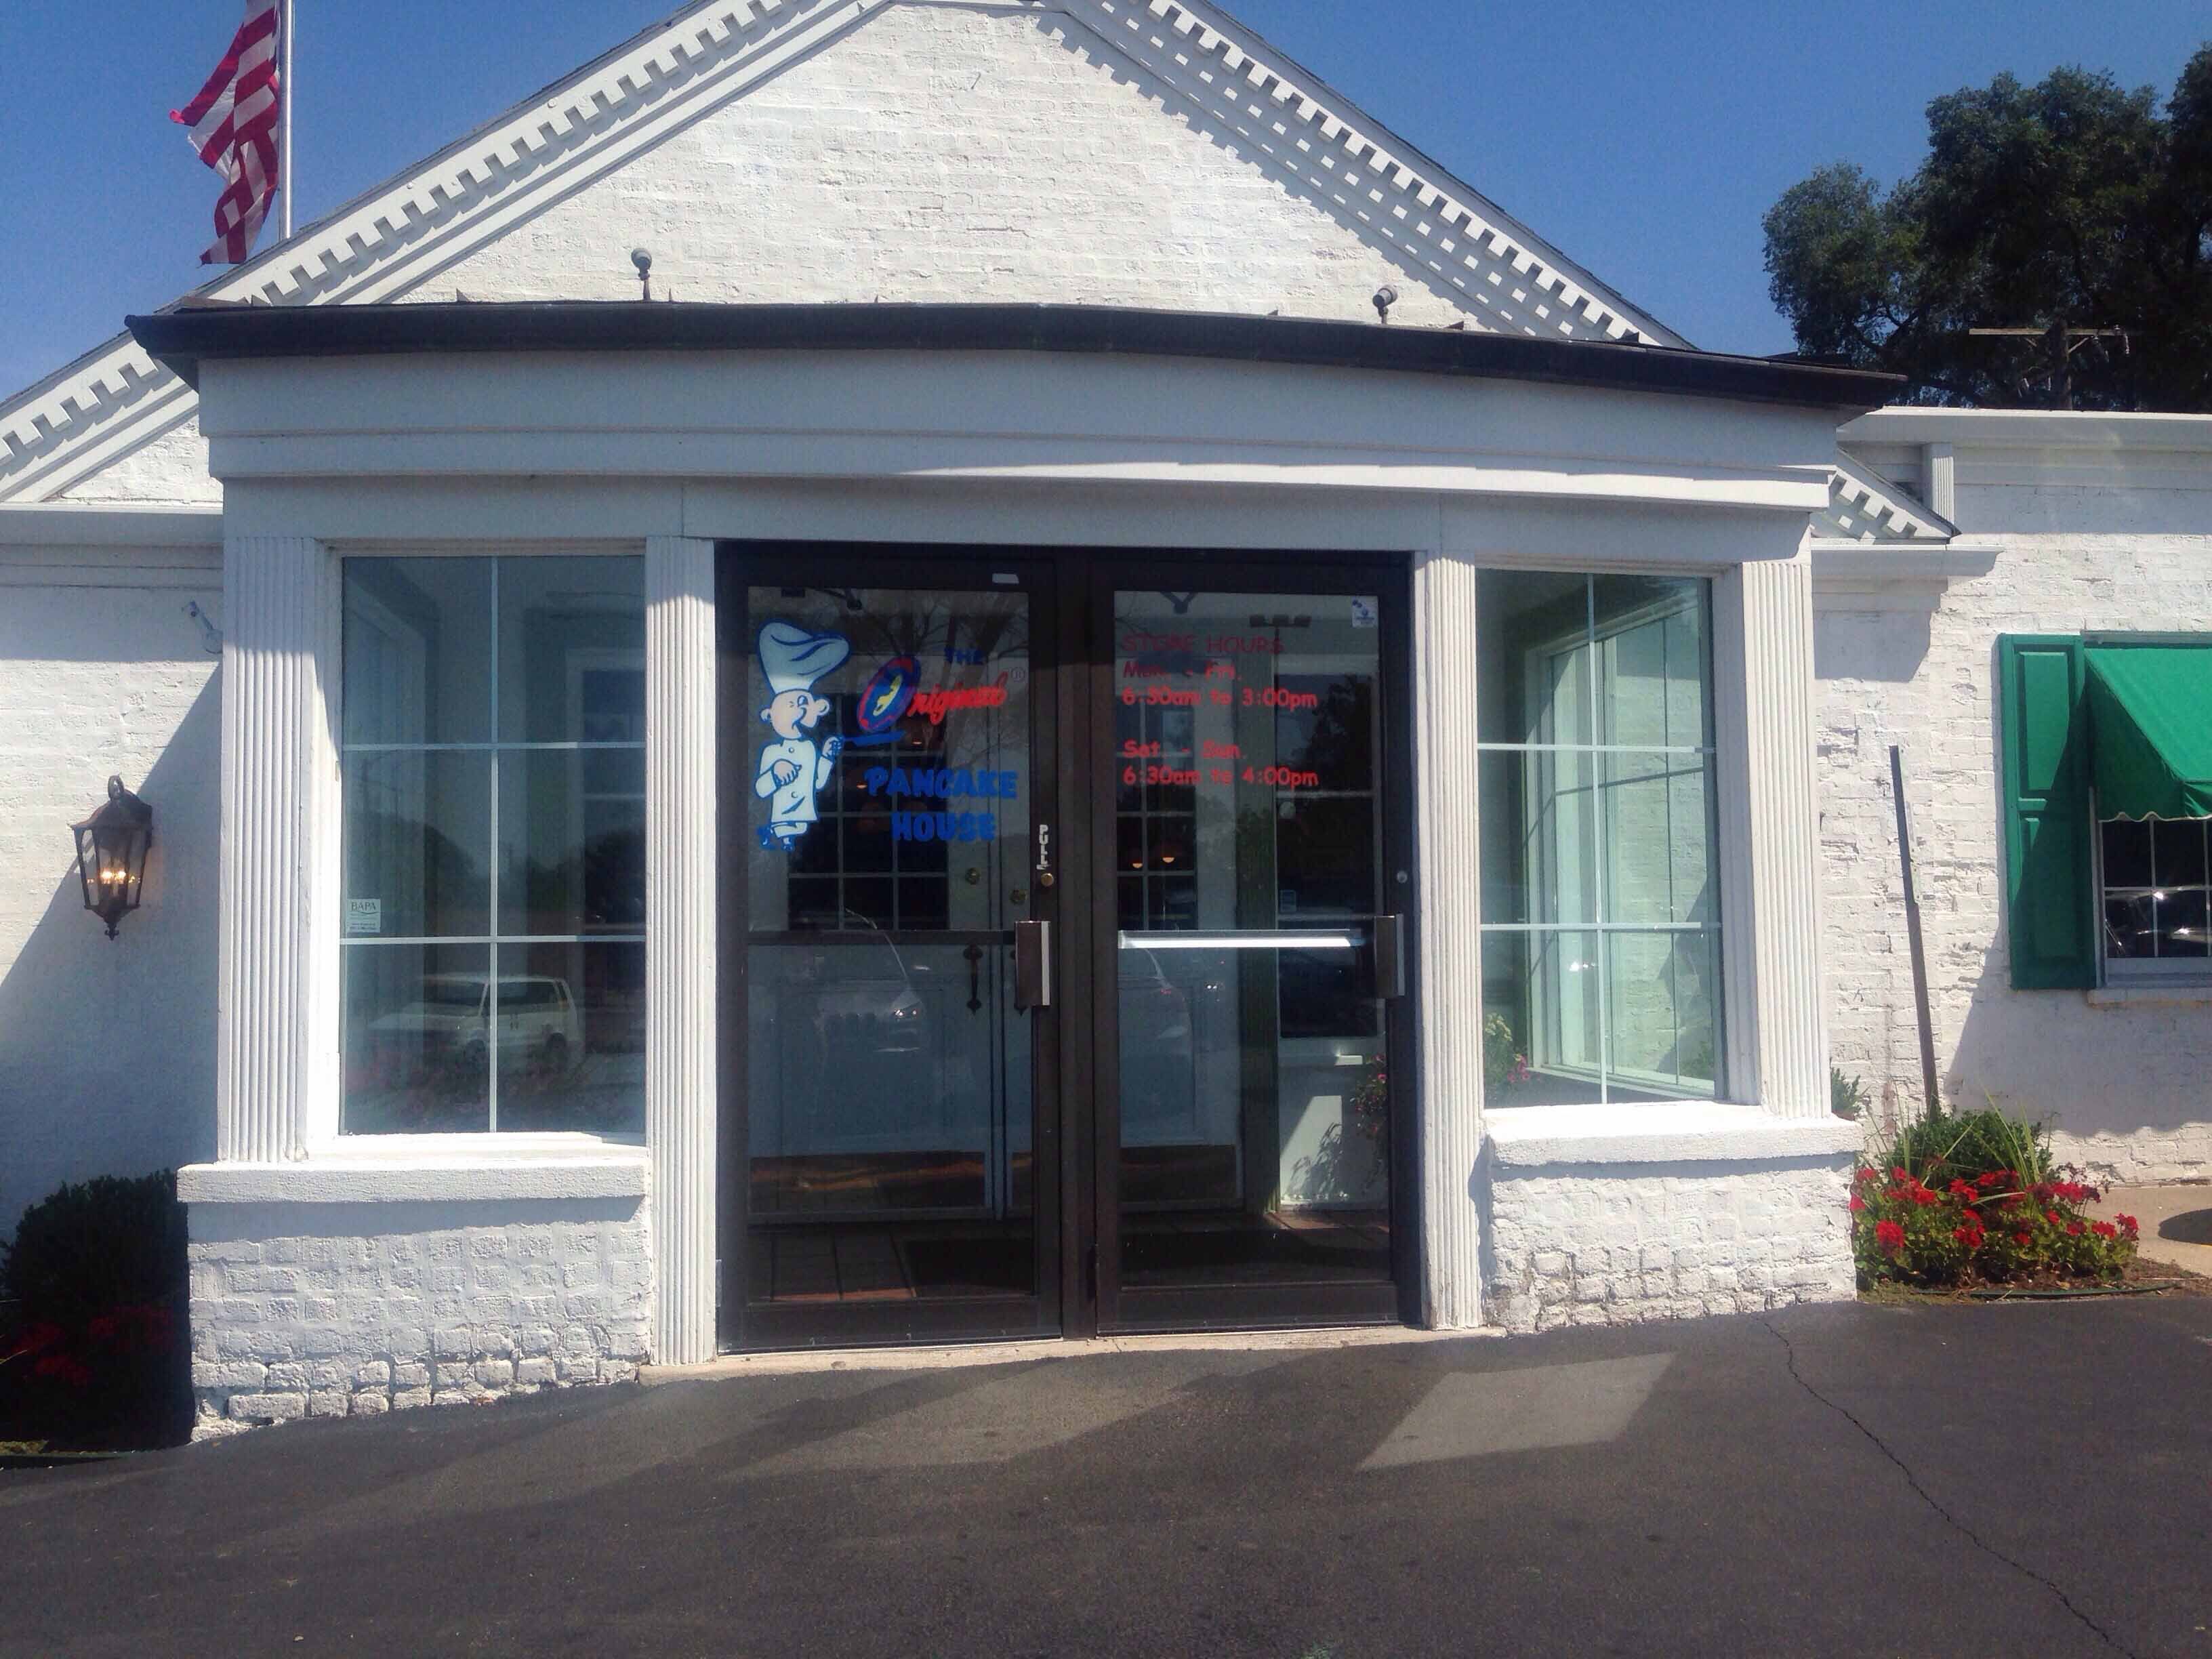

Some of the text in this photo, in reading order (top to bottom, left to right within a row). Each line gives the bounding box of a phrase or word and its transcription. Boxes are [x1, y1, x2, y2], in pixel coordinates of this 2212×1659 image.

[944, 646, 983, 665] THE
[1122, 633, 1285, 655] STORE HOURS
[1122, 686, 1318, 712] 6:30am to 3:00pm
[865, 767, 1018, 800] PANCAKE
[1122, 765, 1319, 789] 6:30am to 4:00pm
[891, 810, 996, 842] HOUSE
[1039, 824, 1049, 866] PULL
